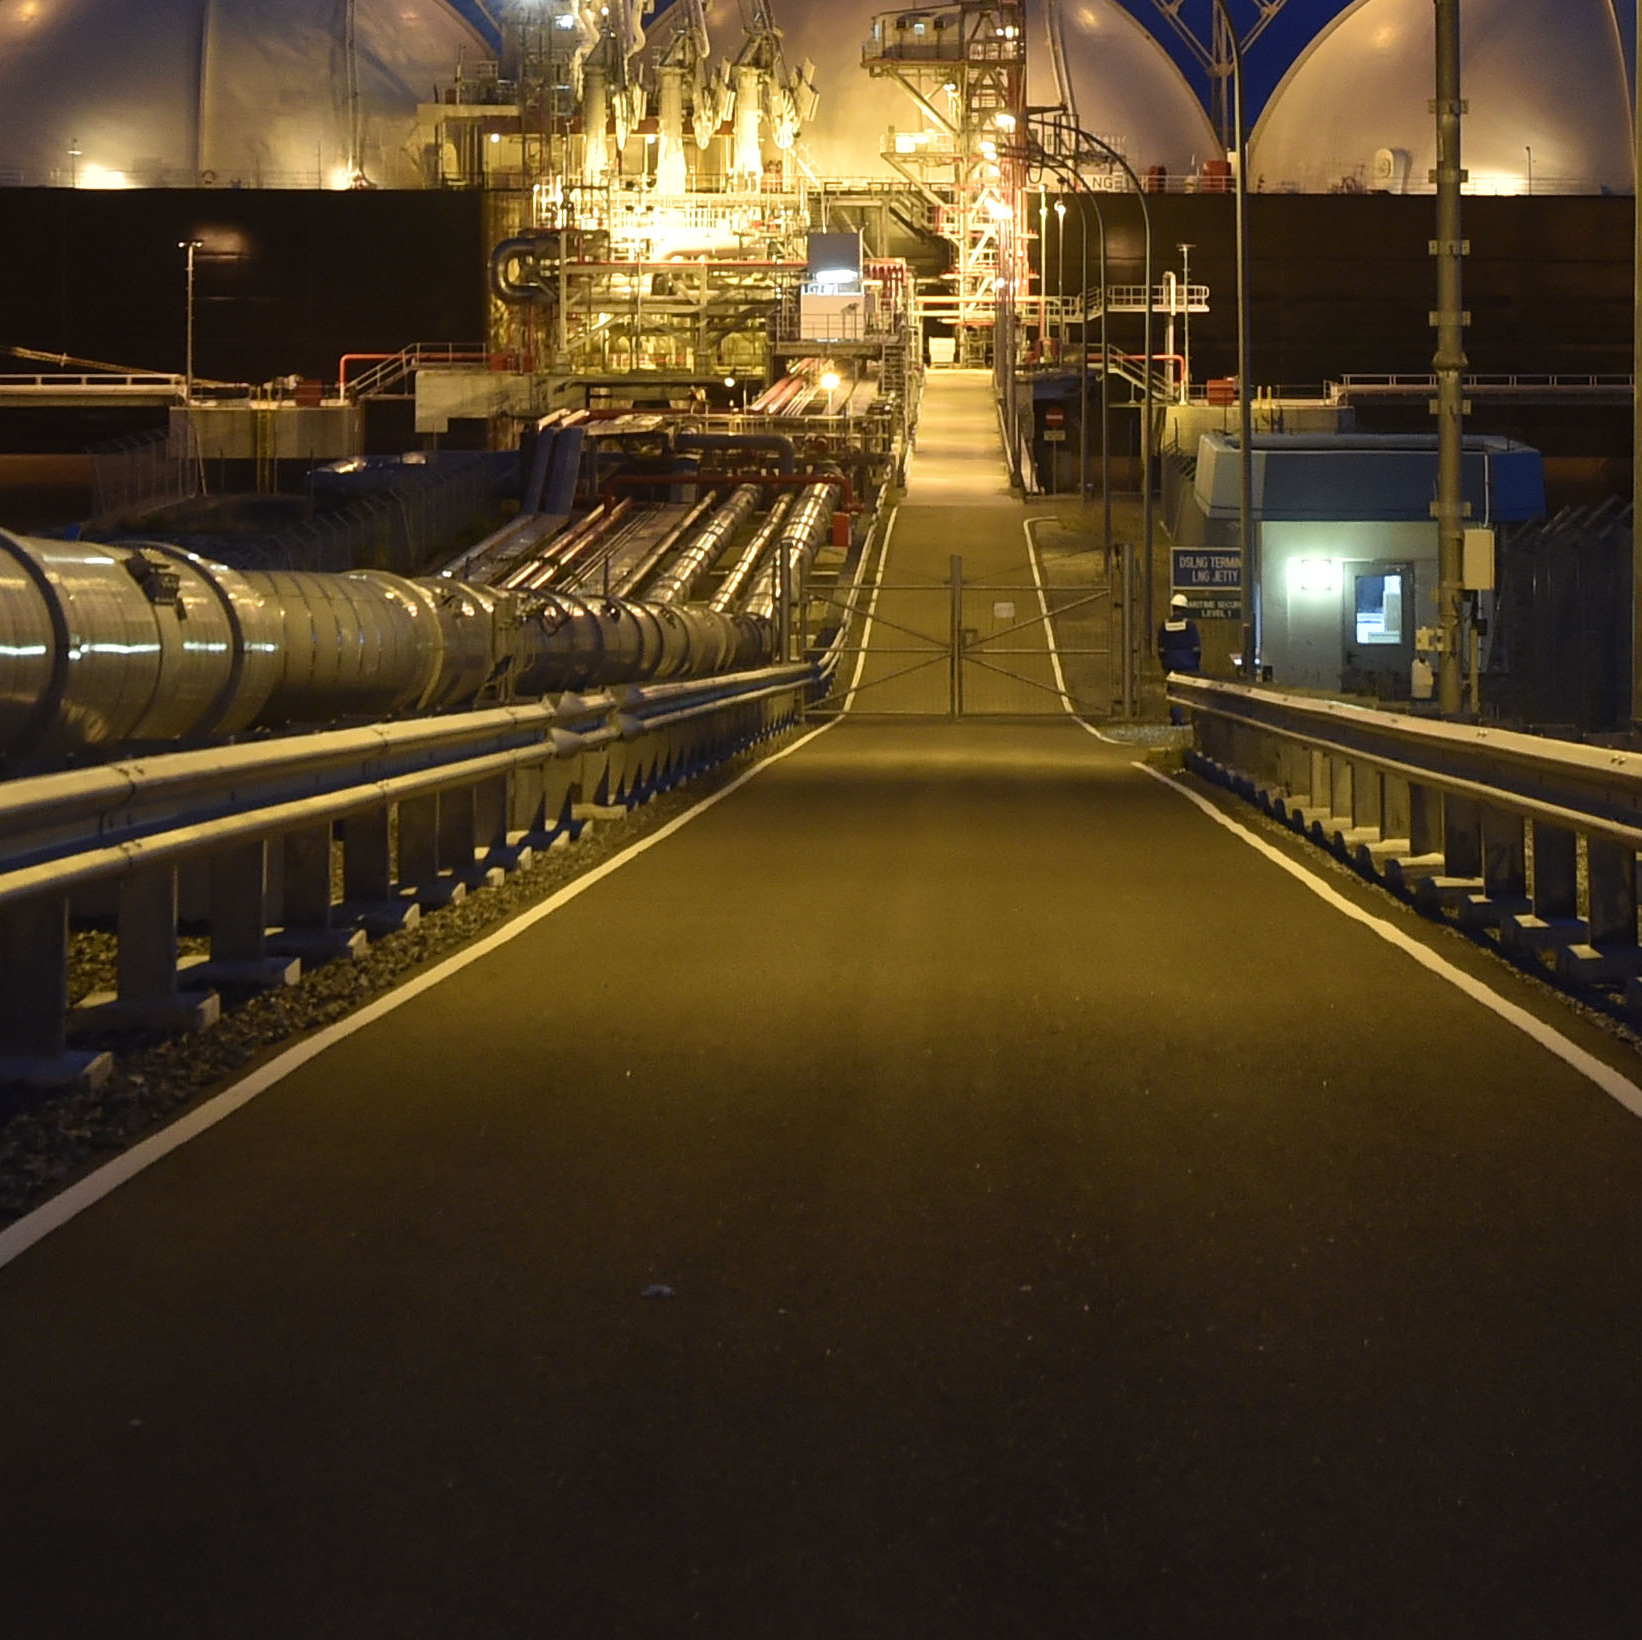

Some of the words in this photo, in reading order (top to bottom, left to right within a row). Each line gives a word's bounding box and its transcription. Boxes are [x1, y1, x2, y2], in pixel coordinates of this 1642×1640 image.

[1179, 556, 1208, 569] DSLNG
[1192, 569, 1210, 583] LNG
[1212, 569, 1238, 583] JETTY
[1201, 609, 1226, 617] LEVEL
